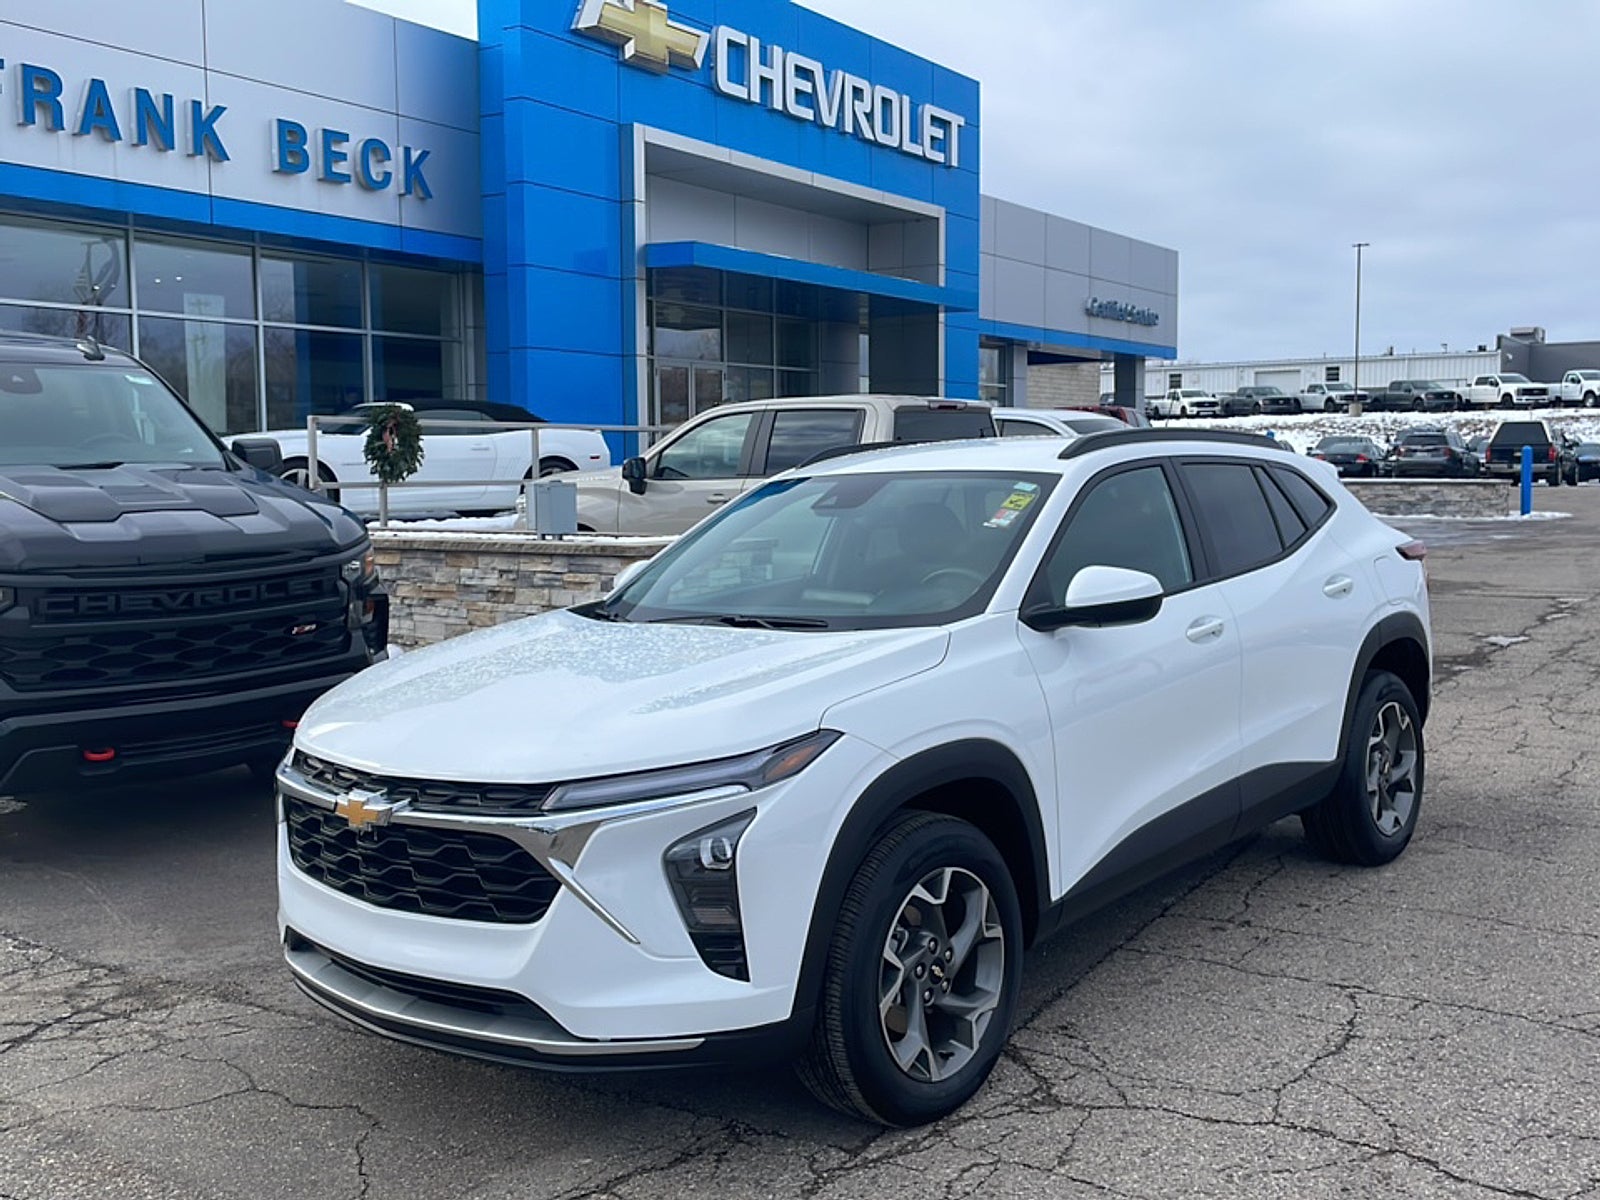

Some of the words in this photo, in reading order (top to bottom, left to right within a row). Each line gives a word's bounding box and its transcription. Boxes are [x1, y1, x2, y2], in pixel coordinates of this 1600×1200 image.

[0, 59, 230, 162] RANK
[270, 118, 433, 200] BECK
[711, 25, 965, 168] CHEVROLET
